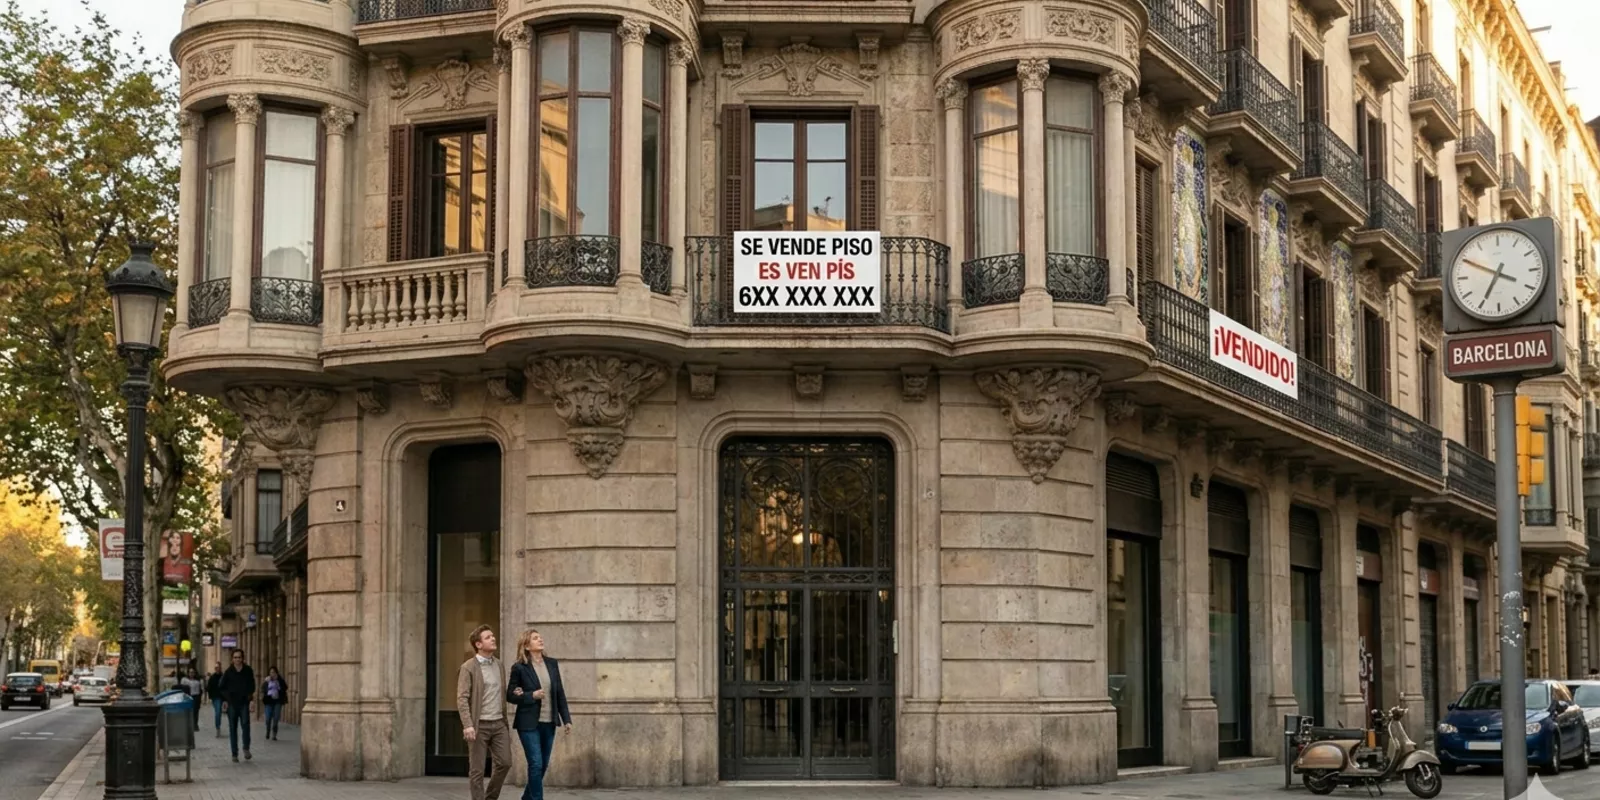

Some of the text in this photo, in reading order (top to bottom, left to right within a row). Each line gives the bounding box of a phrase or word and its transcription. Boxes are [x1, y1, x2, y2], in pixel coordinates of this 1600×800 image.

[741, 238, 872, 255] SE VENDE PISO
[758, 258, 855, 280] ES VEN PÍS
[739, 286, 875, 306] 6XX XXX XXX
[1214, 325, 1294, 386] ¡VENDIDO!
[1453, 339, 1547, 365] BARCELONA
